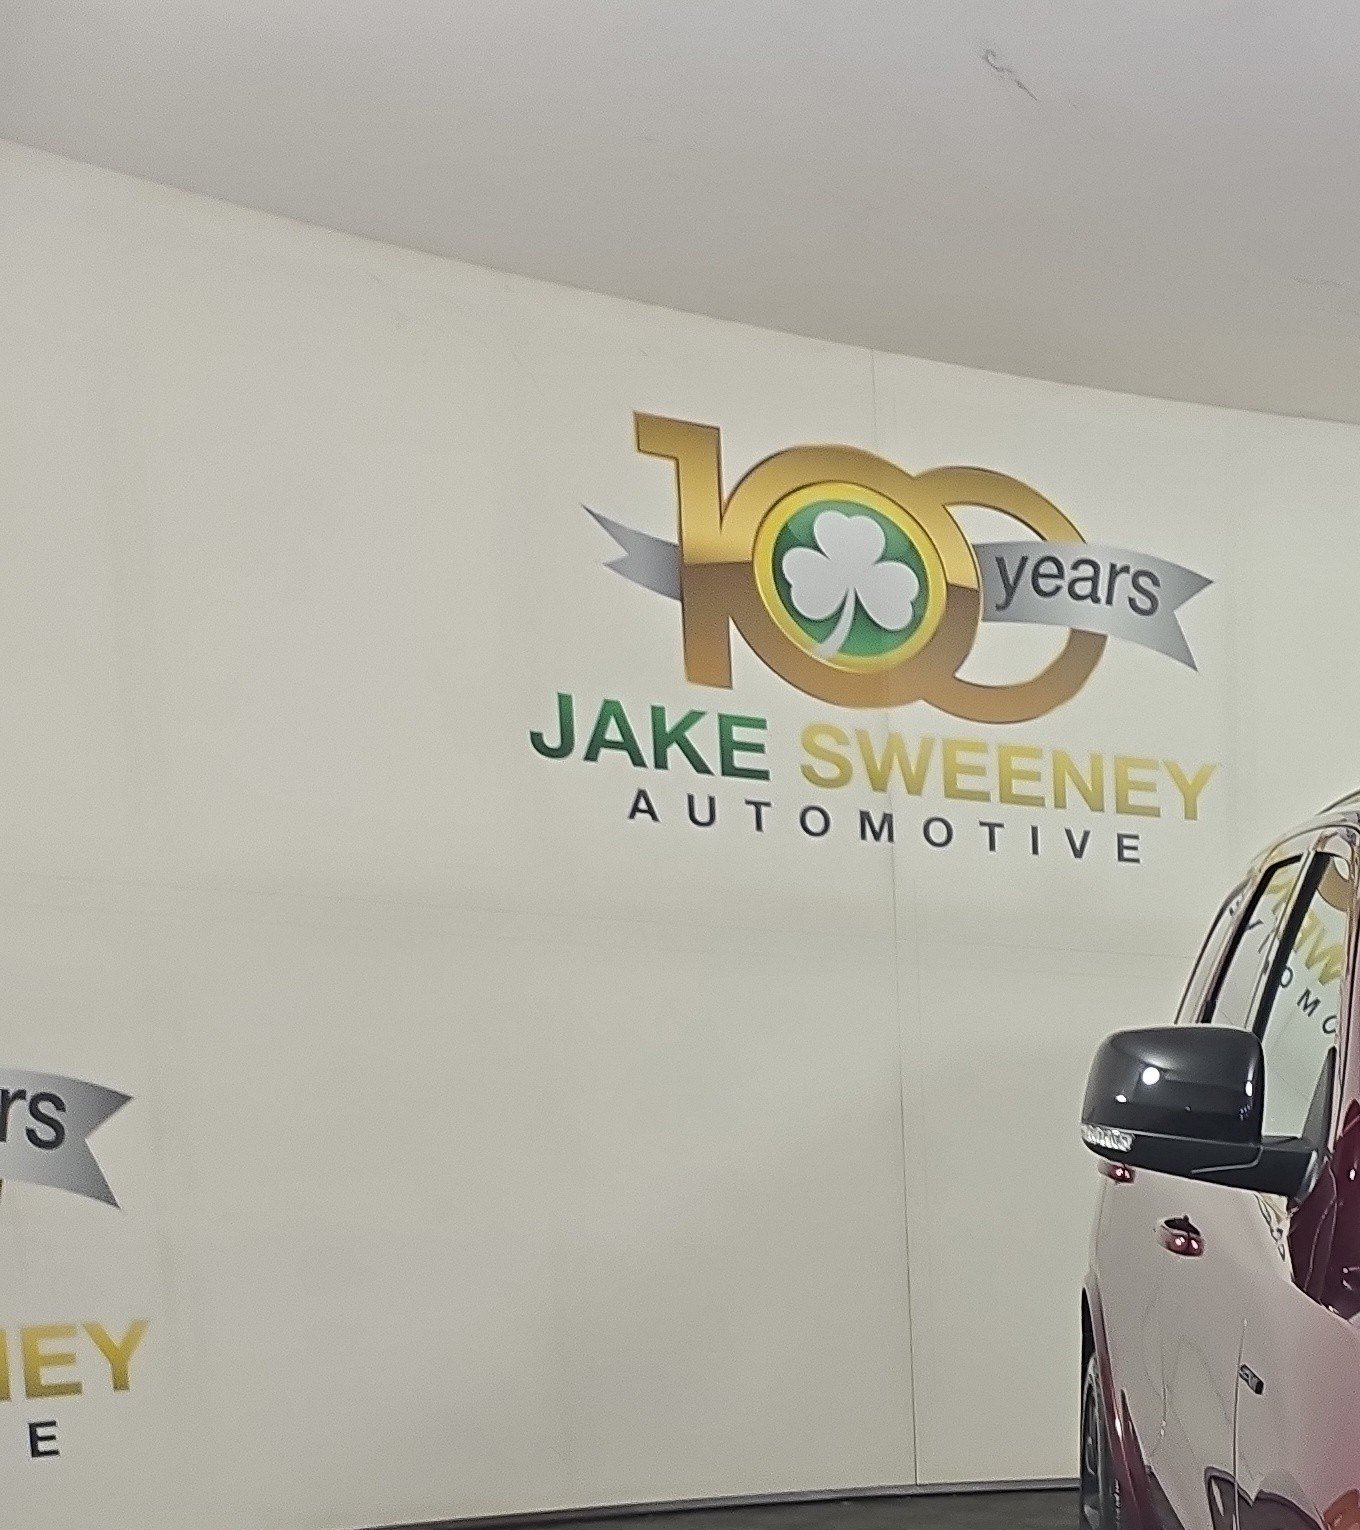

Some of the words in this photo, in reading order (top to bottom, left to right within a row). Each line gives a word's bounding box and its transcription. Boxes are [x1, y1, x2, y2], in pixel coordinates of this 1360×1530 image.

[634, 411, 1110, 724] 100
[994, 547, 1162, 616] years
[530, 692, 771, 781] JAKE
[800, 722, 1219, 821] SWEENEY
[628, 787, 1141, 864] AUTOMOTIVE
